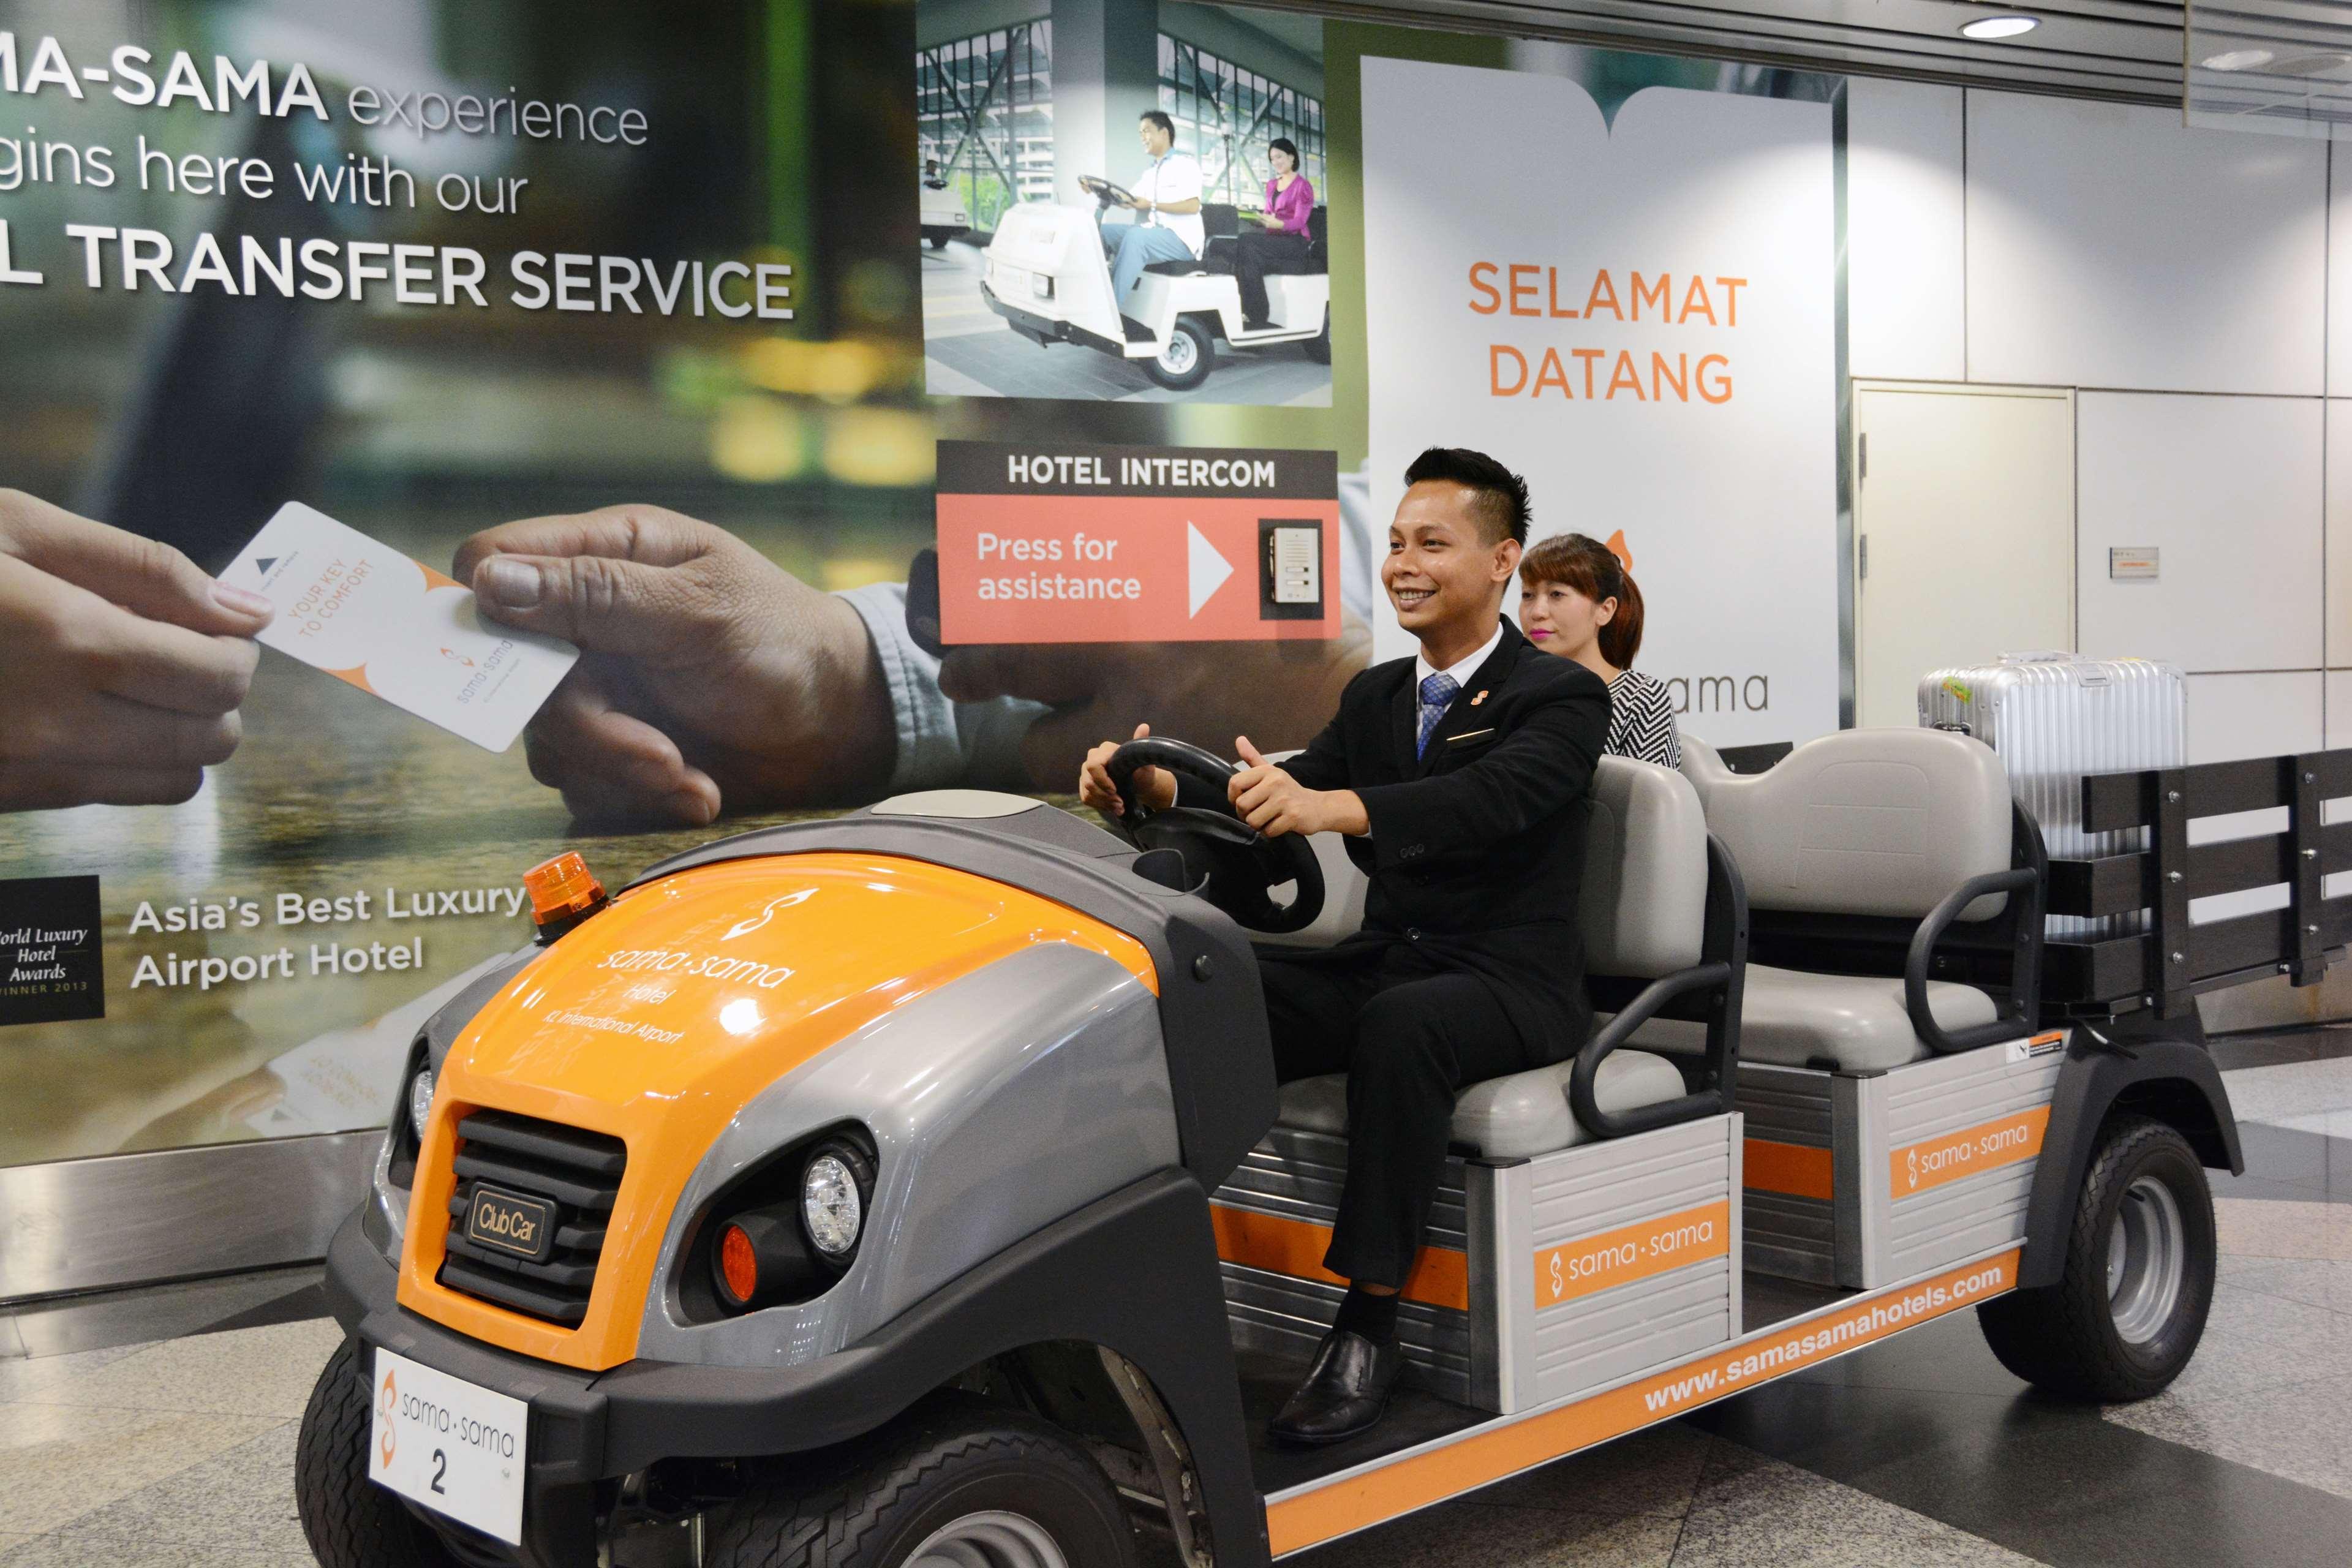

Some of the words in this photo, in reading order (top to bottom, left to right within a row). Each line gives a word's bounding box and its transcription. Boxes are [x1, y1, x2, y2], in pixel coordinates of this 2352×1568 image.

[348, 85, 648, 146] experience
[139, 135, 274, 199] here
[295, 153, 415, 208] with
[437, 173, 528, 214] our
[66, 224, 488, 307] TRANSFER
[510, 251, 794, 320] SERVICE
[1468, 262, 1747, 327] SELAMAT
[1490, 345, 1733, 405] DATANG
[1008, 455, 1110, 485] HOTEL
[1121, 458, 1275, 488] INTERCOM
[978, 533, 1062, 562] Press
[1072, 532, 1118, 562] for
[288, 584, 325, 619] YOUR
[319, 558, 347, 586] KEY
[299, 620, 322, 638] TO
[318, 559, 374, 619] COMFORT
[978, 572, 1141, 601] assistance
[276, 889, 371, 925] Best
[387, 886, 527, 918] Luxury
[0, 927, 31, 945] orld
[35, 928, 88, 946] Luxury
[17, 945, 56, 963] Hotel
[9, 963, 67, 982] Awards
[130, 945, 294, 989] Airport
[311, 937, 423, 975] Hotel
[0, 984, 47, 996] INNER
[55, 981, 88, 993] 2013
[622, 983, 677, 1005] Hotel
[543, 1010, 557, 1023] KL
[558, 1012, 639, 1034] International
[635, 1023, 685, 1045] Airport
[1644, 1266, 2002, 1411] www.samasamahotels.com
[431, 1447, 447, 1495] 2
